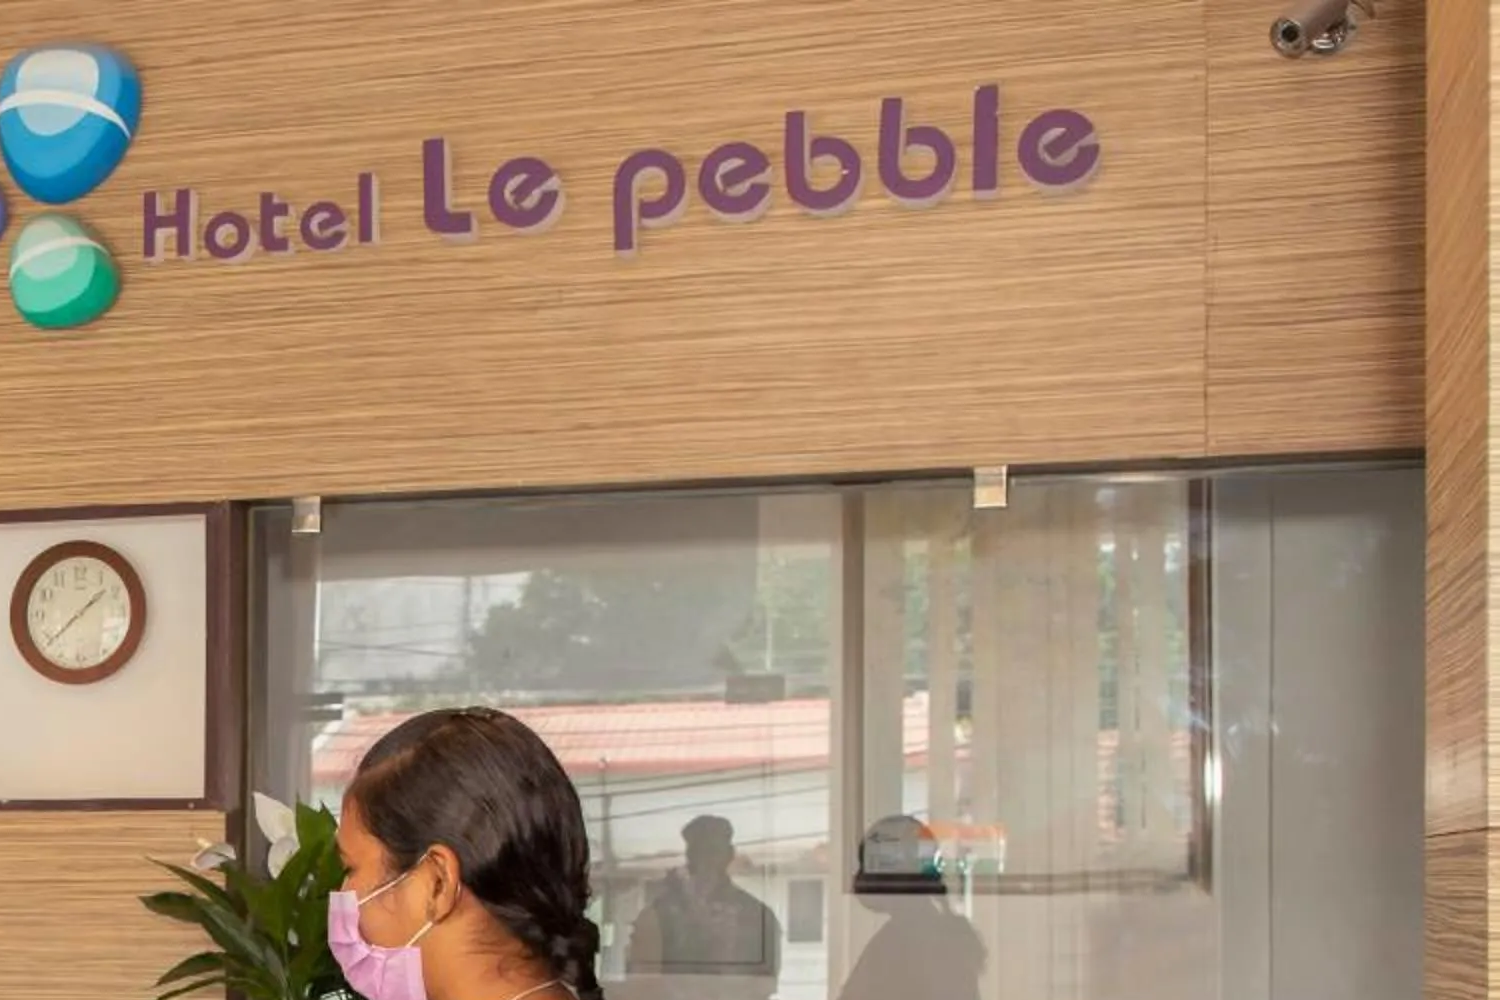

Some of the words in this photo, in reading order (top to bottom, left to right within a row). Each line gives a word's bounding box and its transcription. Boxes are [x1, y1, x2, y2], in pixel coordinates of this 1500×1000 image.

[143, 171, 376, 261] Hotel
[422, 137, 562, 235] Le
[613, 84, 1101, 252] pebble
